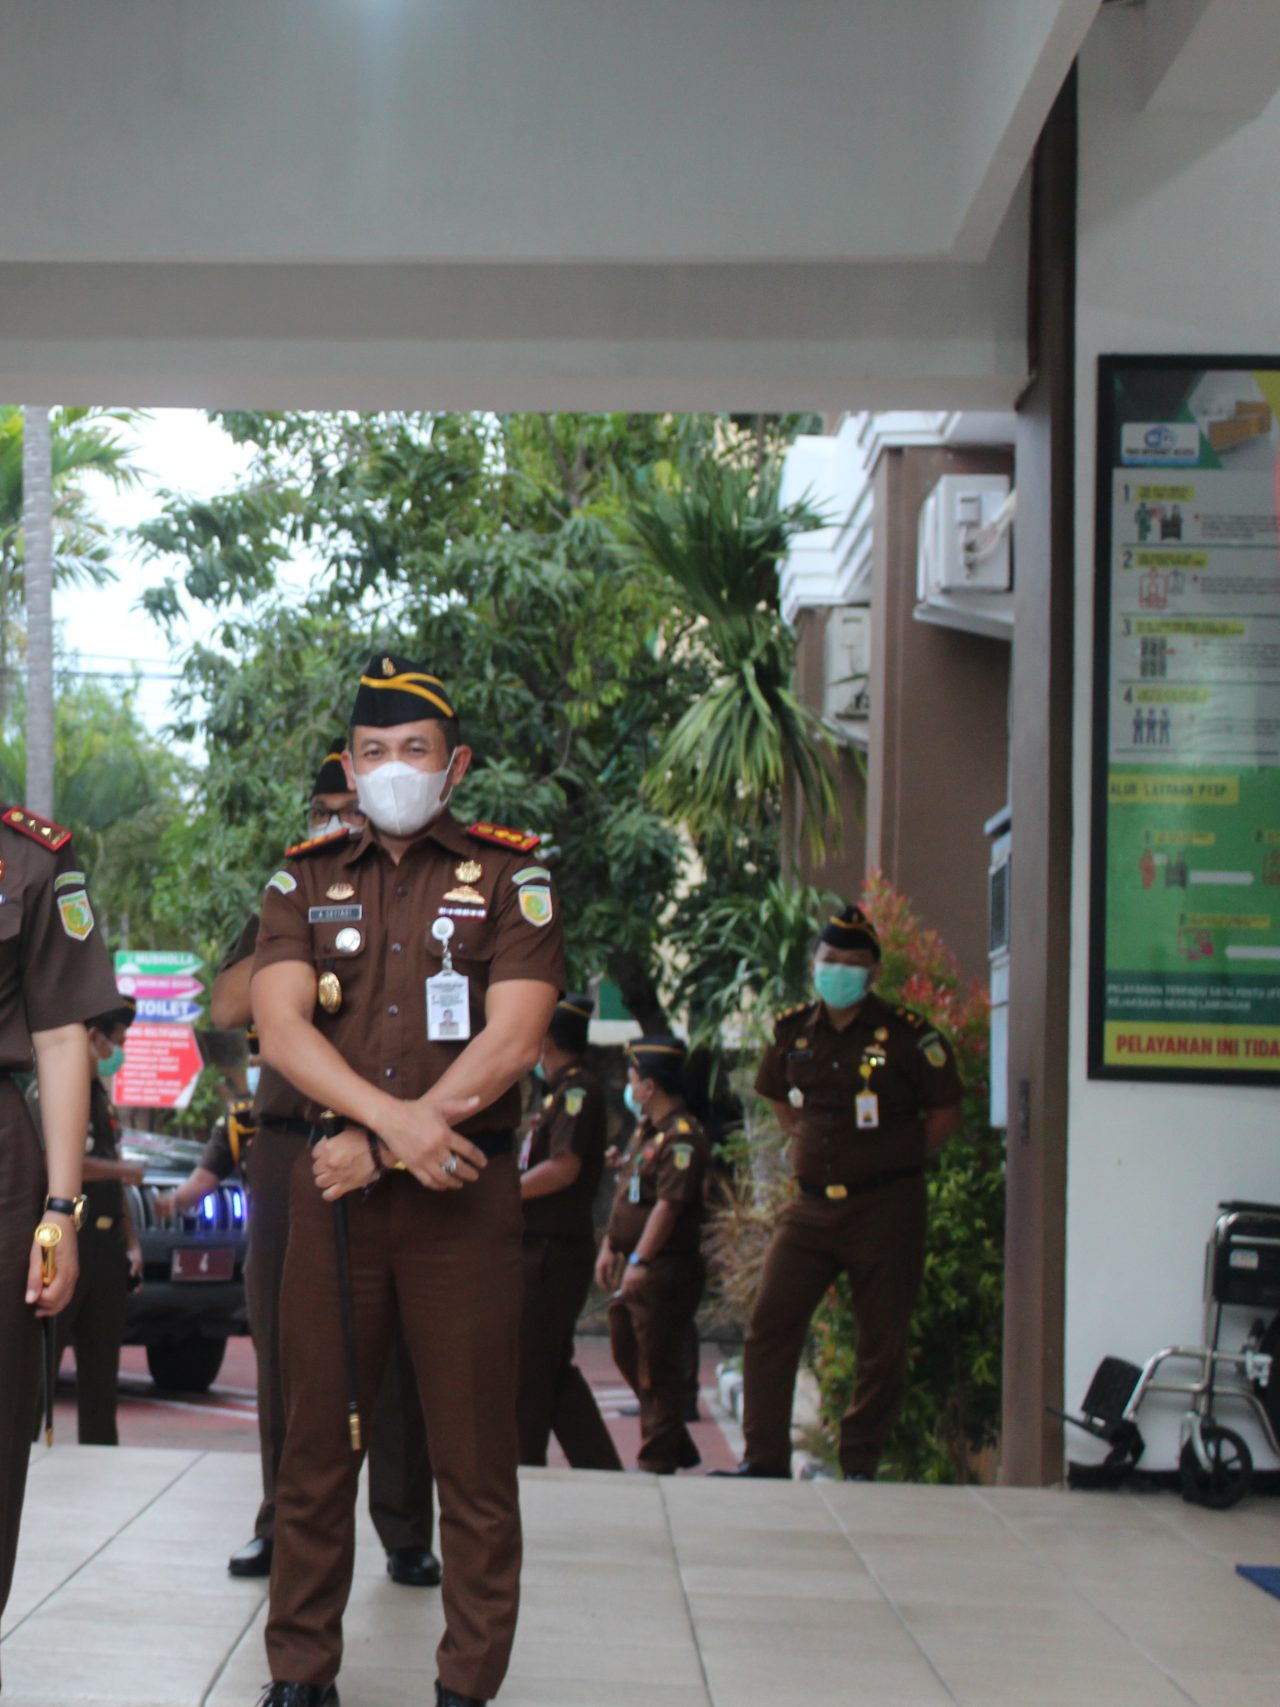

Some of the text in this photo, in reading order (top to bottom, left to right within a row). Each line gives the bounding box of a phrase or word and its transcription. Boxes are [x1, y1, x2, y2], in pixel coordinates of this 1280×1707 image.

[136, 1000, 191, 1016] TOILET
[1116, 1033, 1213, 1055] PELAYANAN
[1216, 1037, 1239, 1057] INI
